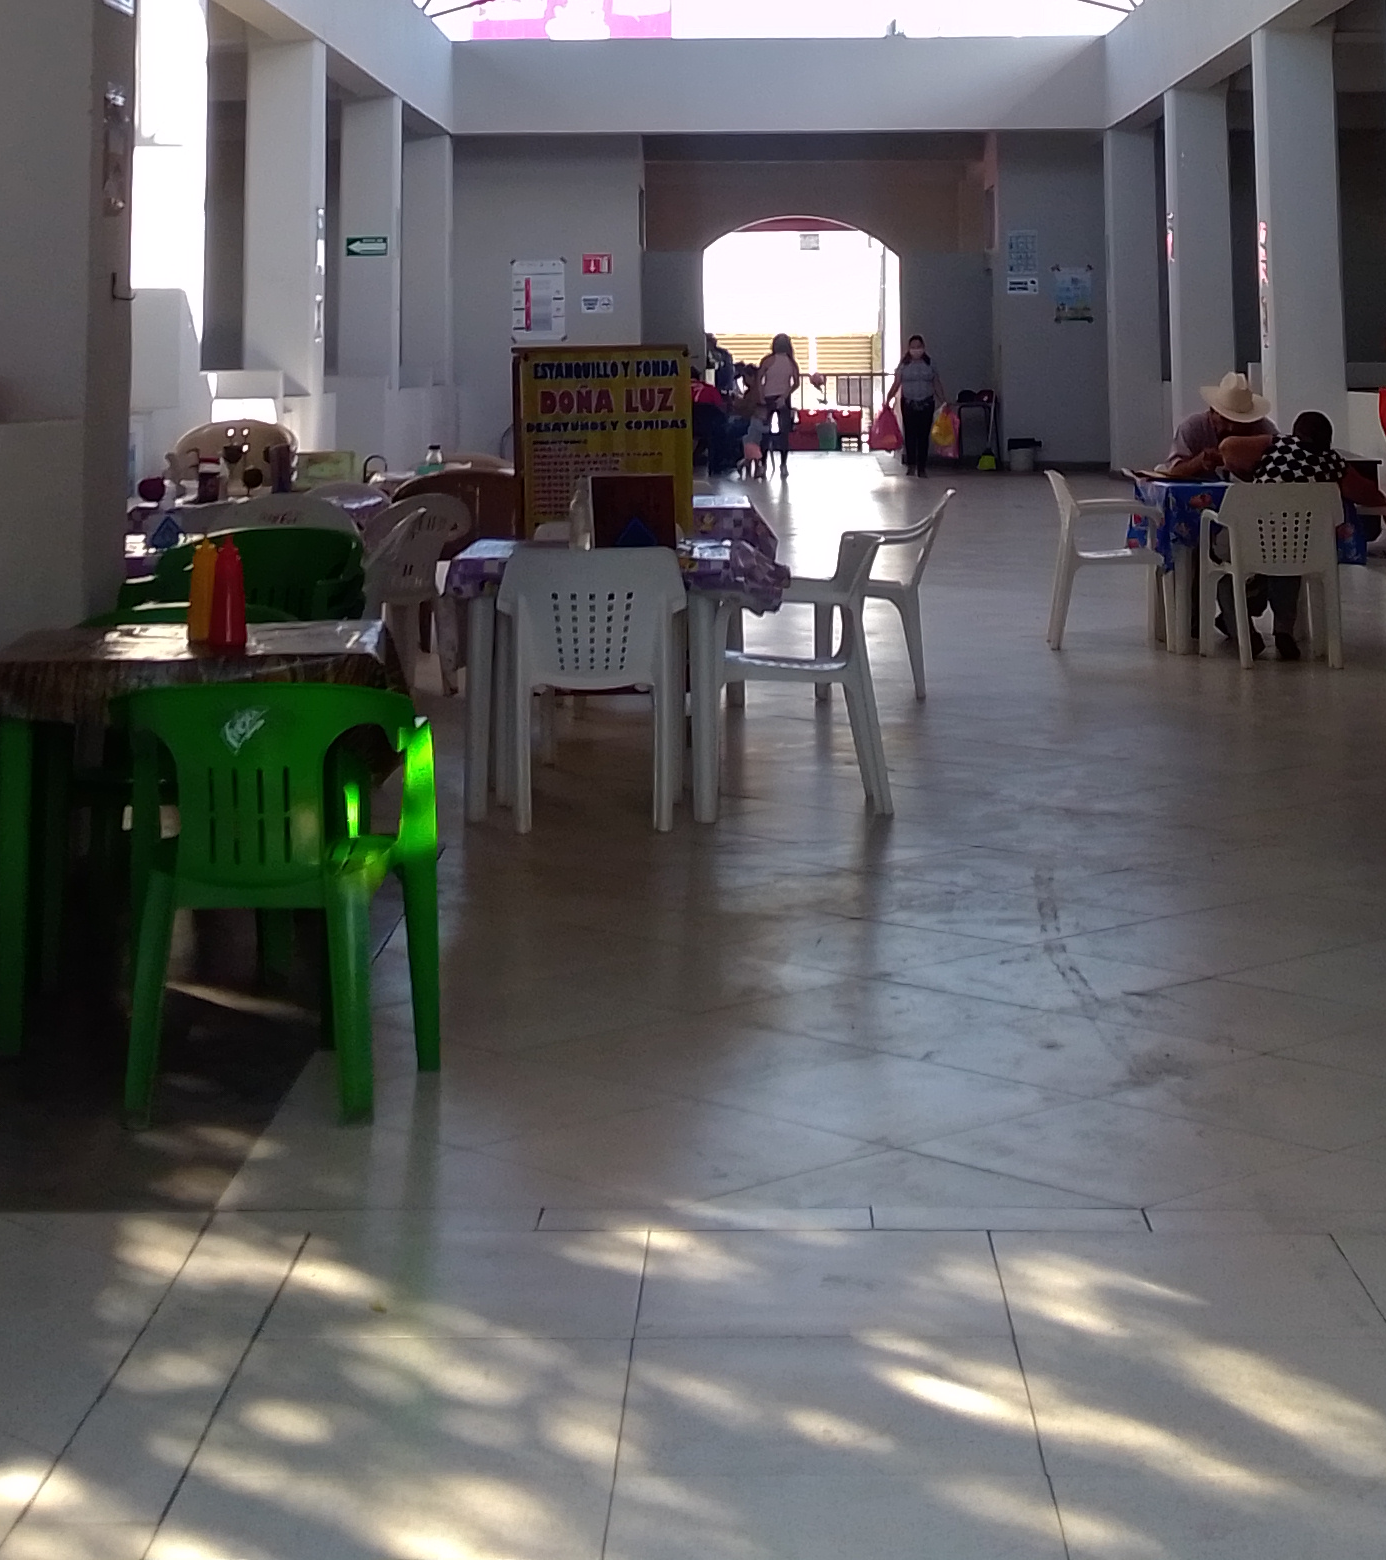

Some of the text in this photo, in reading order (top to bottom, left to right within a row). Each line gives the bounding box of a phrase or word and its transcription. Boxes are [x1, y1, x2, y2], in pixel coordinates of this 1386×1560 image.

[533, 359, 679, 380] ESTANQUILLO Y FONDA
[539, 385, 675, 415] DOÑA LUZ
[526, 418, 688, 433] DESAYUNOS Y COMIDAS
